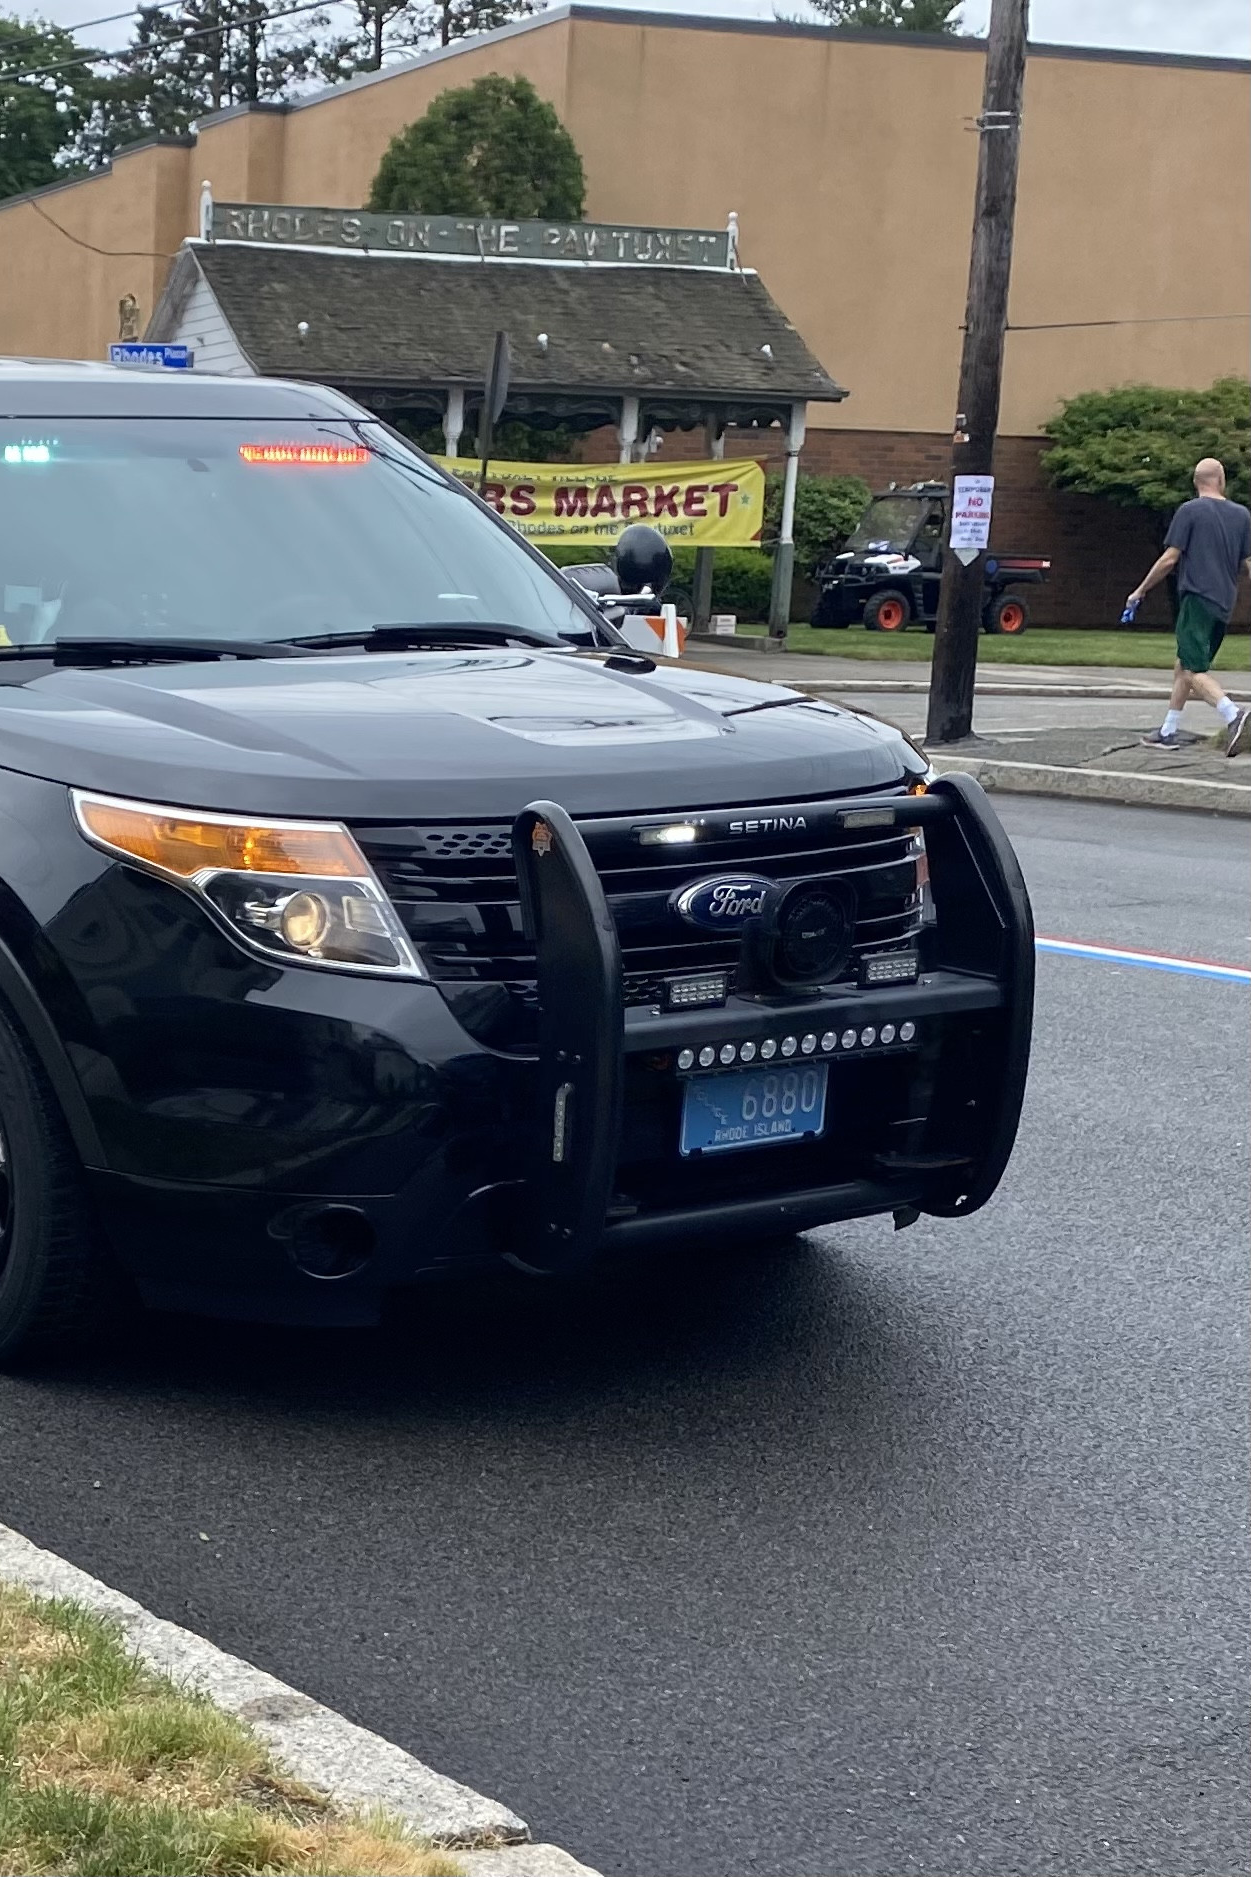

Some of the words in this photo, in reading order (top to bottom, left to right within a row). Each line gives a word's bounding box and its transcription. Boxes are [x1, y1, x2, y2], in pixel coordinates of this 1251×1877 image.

[226, 208, 361, 243] RHODES
[387, 220, 431, 247] ON
[456, 222, 520, 252] THE
[554, 483, 739, 518] MARKET
[968, 496, 984, 507] NO
[955, 511, 990, 519] PARKING
[729, 816, 807, 835] SETINA
[709, 884, 767, 917] Ford
[742, 1070, 819, 1121] 6880
[714, 1125, 749, 1142] RHODE
[754, 1118, 793, 1137] ISLAND
